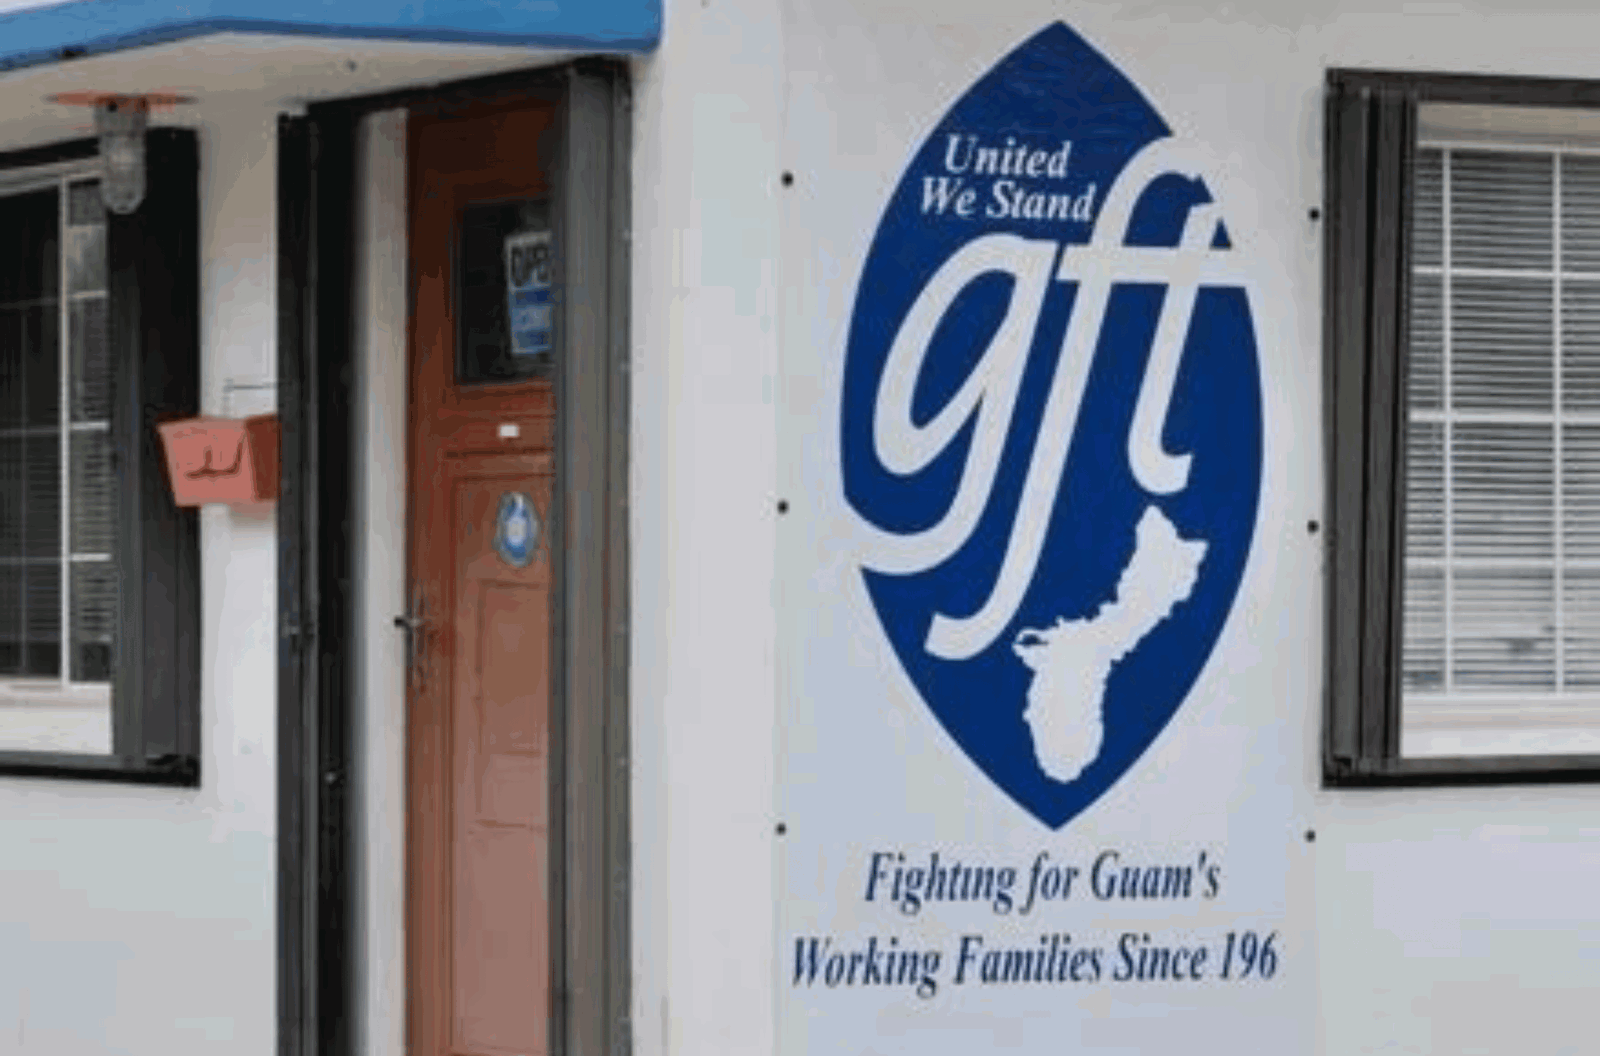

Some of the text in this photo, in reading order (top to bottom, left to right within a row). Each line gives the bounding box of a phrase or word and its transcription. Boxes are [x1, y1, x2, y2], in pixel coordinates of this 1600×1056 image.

[944, 134, 1072, 178] United
[922, 177, 1096, 221] We Stand
[846, 136, 1255, 660] gft
[864, 850, 1221, 916] Fighting for Guam's
[792, 931, 1279, 999] Working Families Since 196
